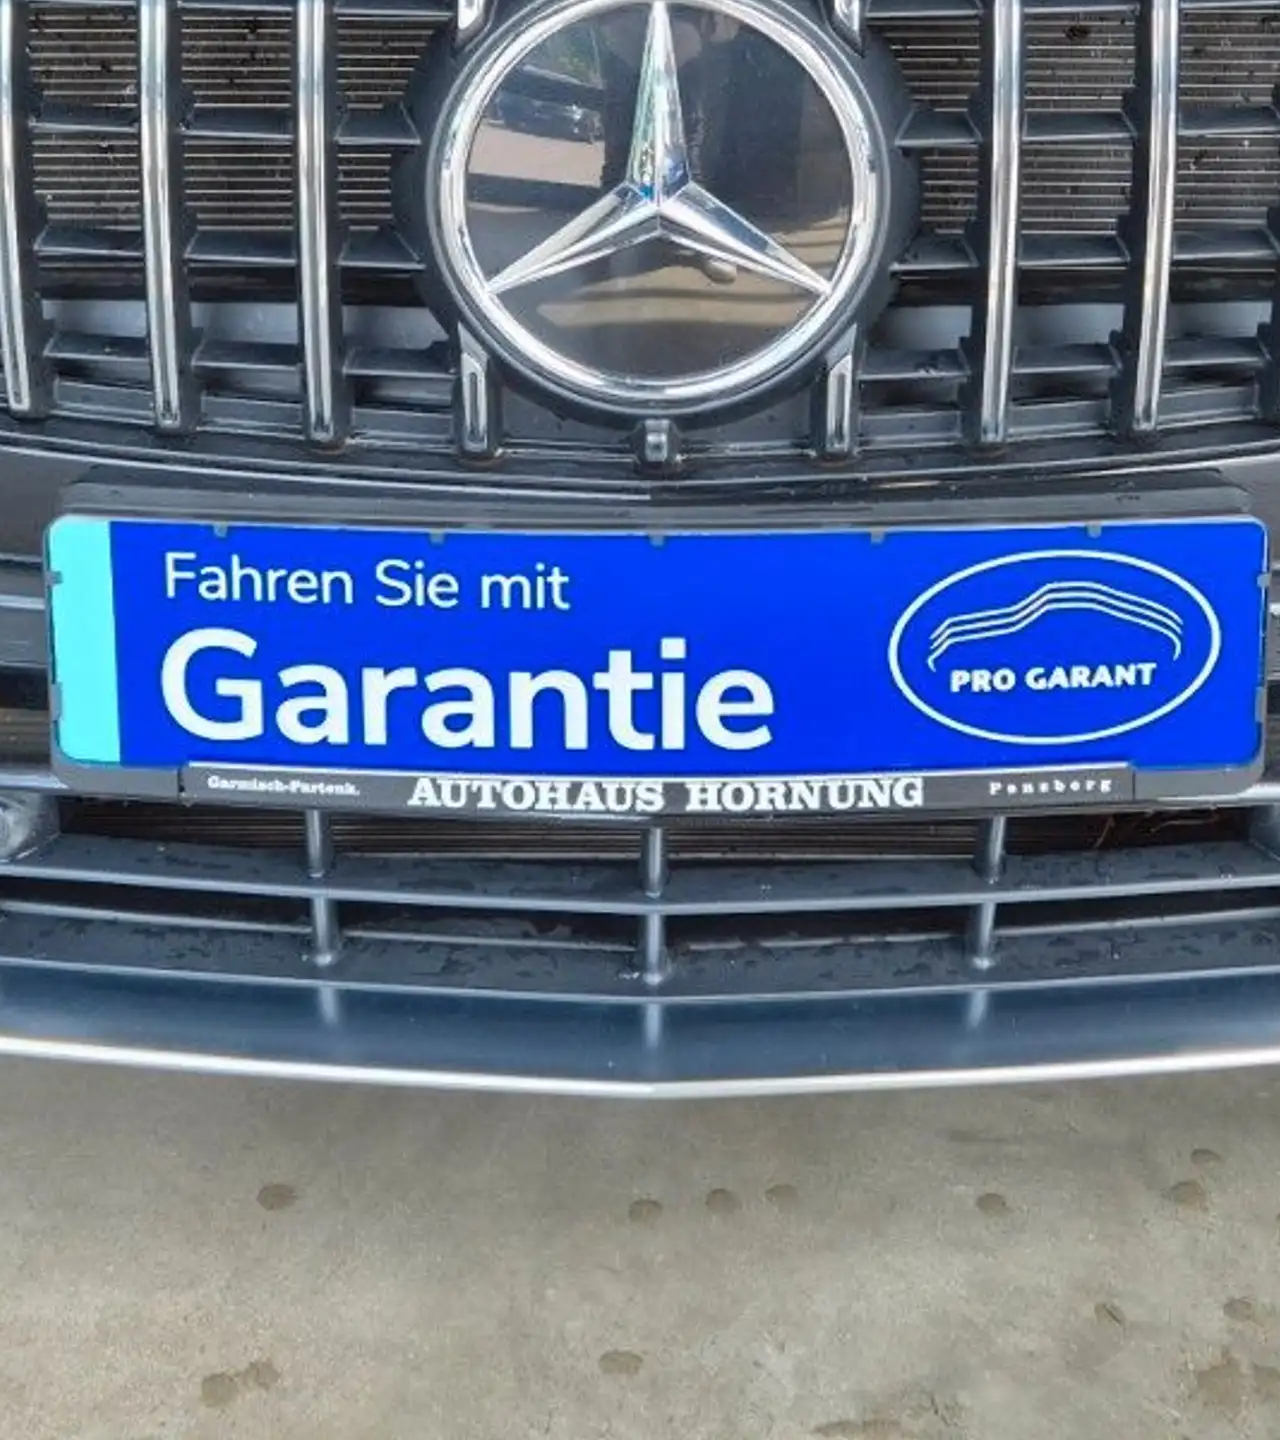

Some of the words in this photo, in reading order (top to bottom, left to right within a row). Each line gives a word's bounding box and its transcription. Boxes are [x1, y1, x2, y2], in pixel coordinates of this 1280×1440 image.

[166, 551, 353, 605] Fahren
[375, 559, 459, 608] Sie
[481, 563, 570, 610] mit
[160, 627, 775, 750] Garantie
[950, 668, 1016, 693] PRO
[1024, 662, 1158, 691] GARANT
[407, 777, 666, 812] AUTOHAUS
[685, 776, 926, 812] HORNUNG
